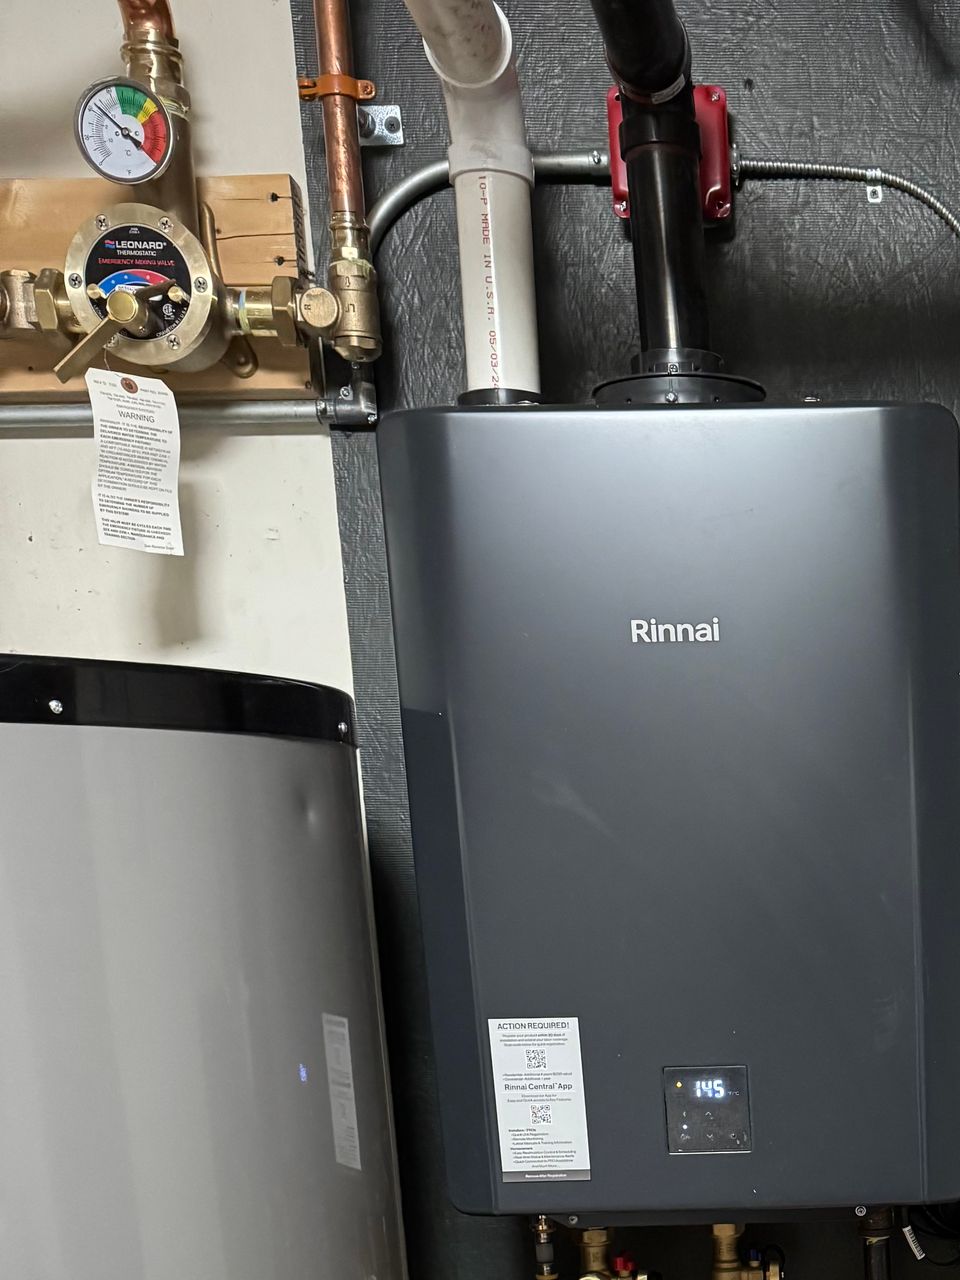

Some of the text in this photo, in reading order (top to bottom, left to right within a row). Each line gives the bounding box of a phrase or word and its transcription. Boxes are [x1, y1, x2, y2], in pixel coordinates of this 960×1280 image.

[480, 213, 490, 244] MADE
[483, 253, 491, 268] IN
[484, 275, 495, 321] U.S.A.
[118, 410, 155, 423] WARNING
[630, 617, 720, 642] Rinnai
[696, 1080, 724, 1098] 145
